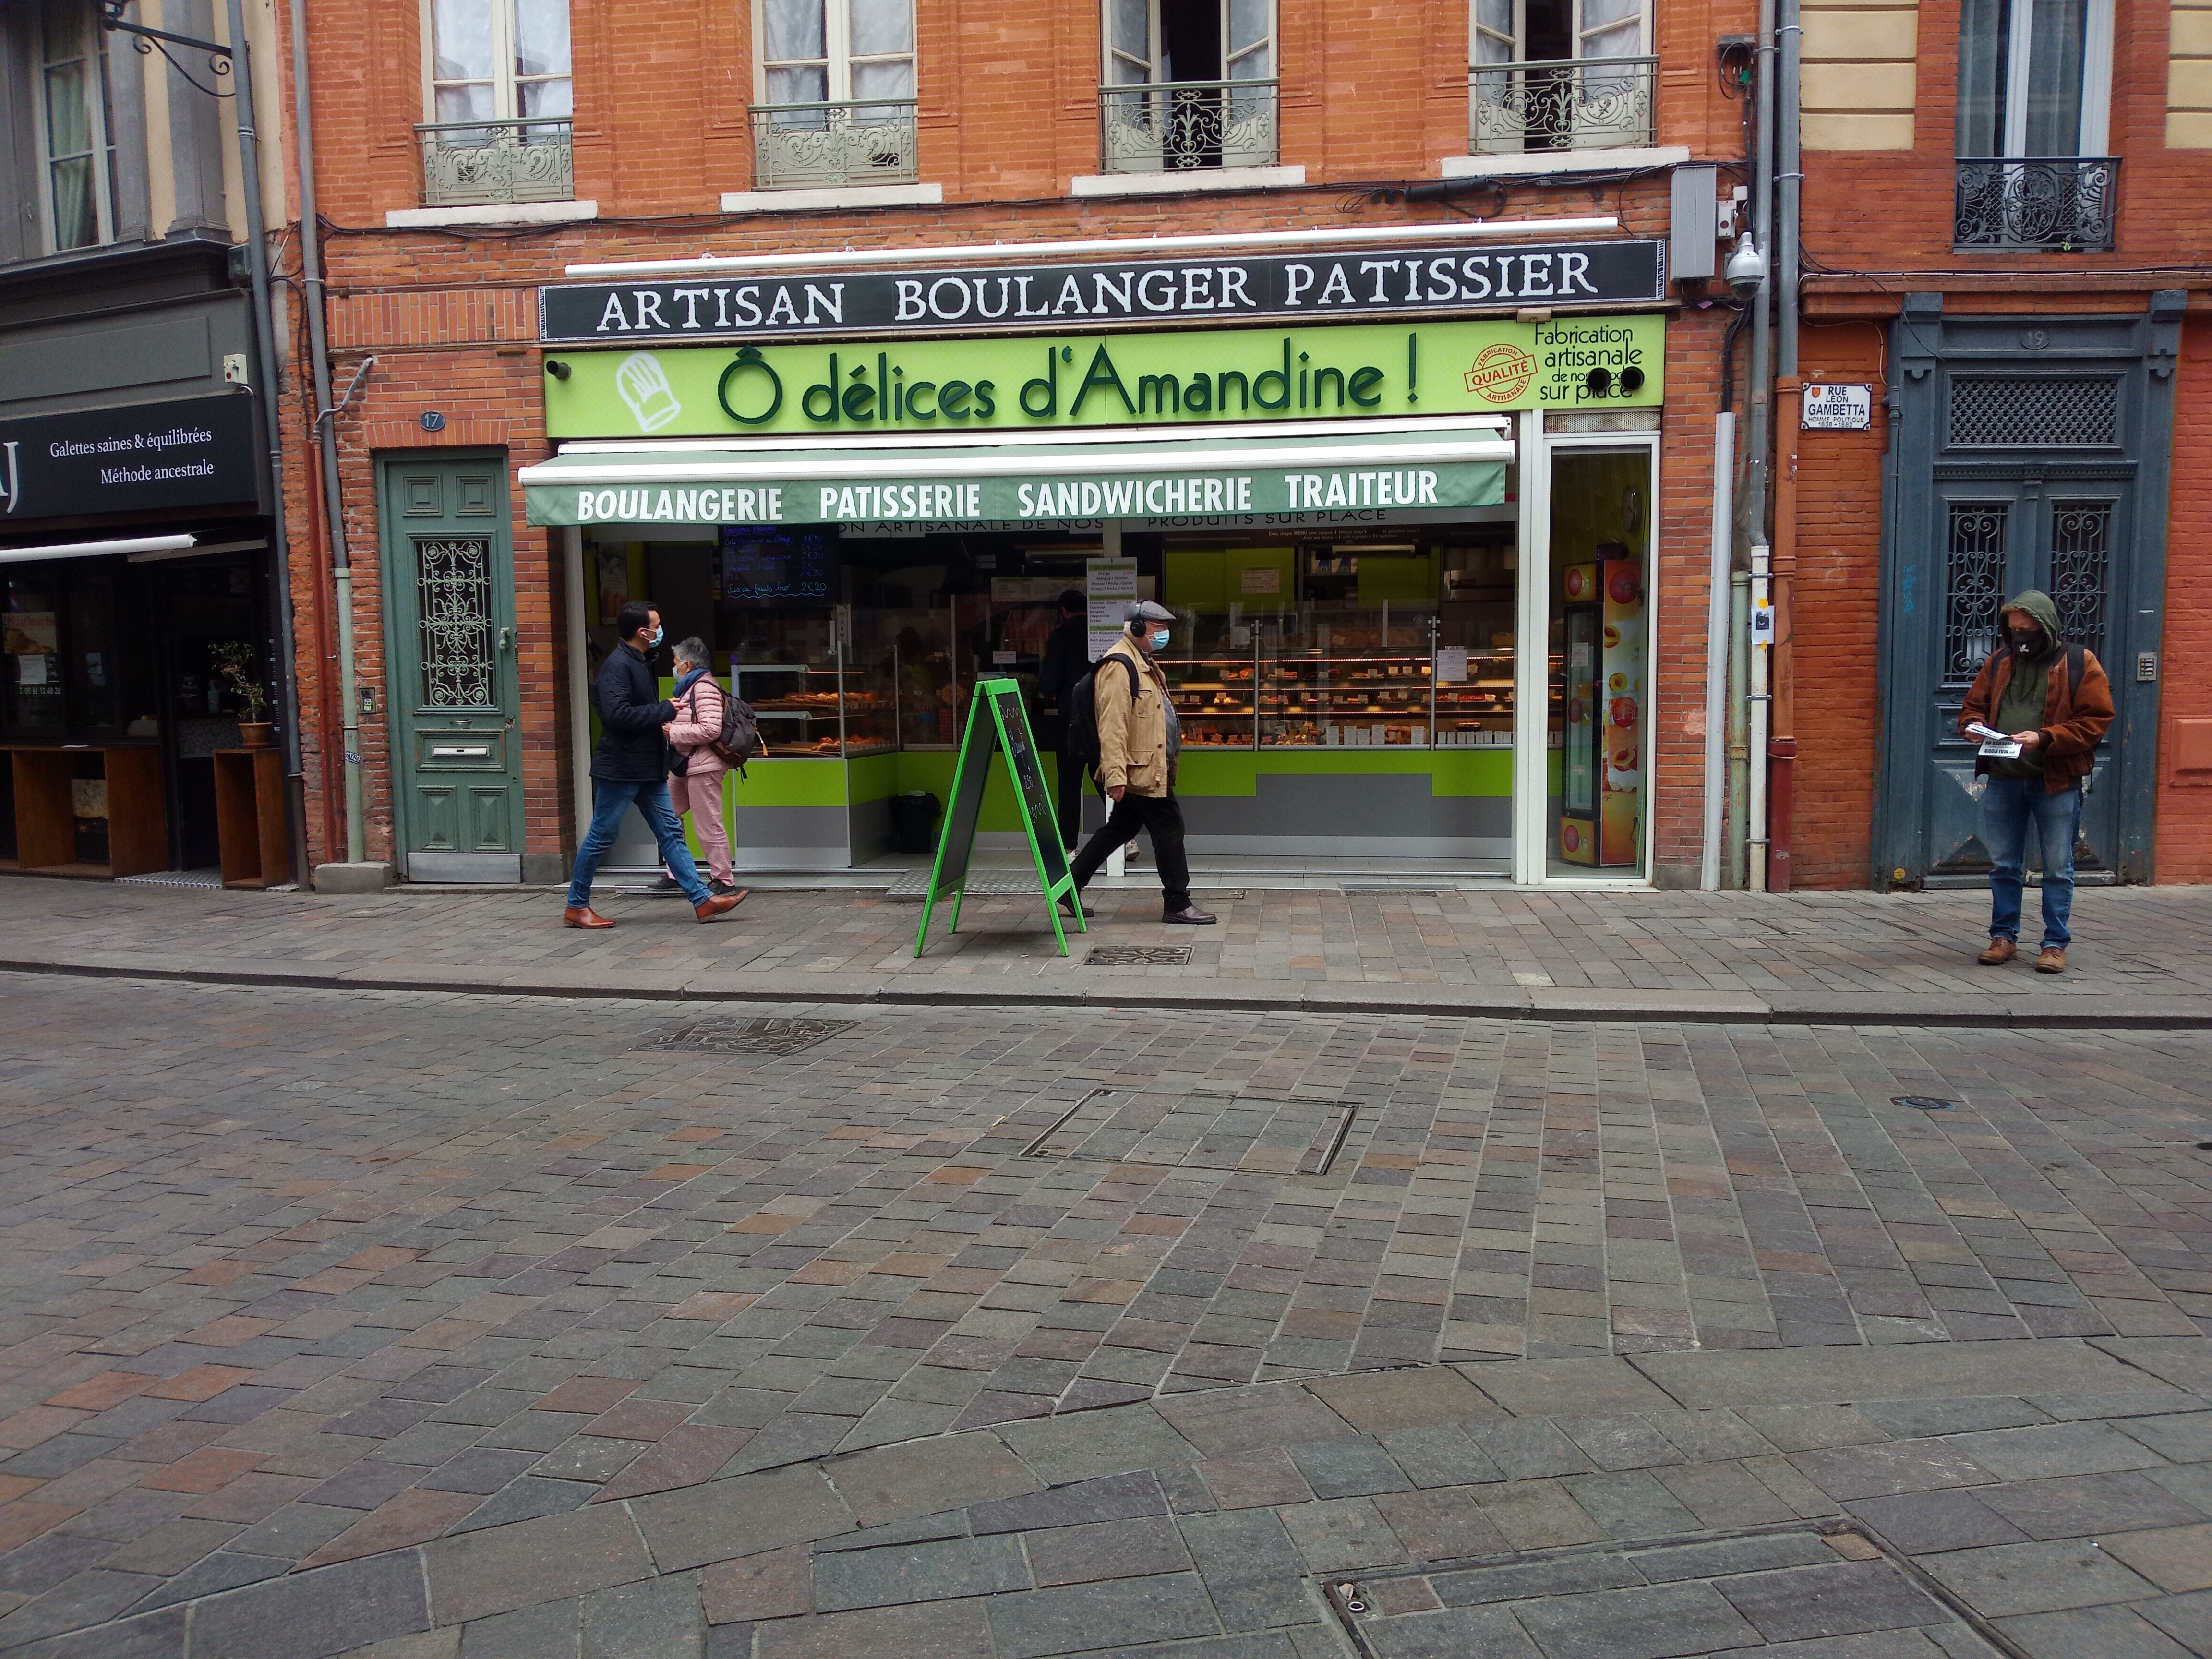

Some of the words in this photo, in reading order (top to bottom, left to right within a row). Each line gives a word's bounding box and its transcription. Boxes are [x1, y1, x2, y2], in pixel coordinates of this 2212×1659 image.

[596, 282, 845, 332] ARTISAN
[895, 266, 1256, 321] BOULANGER
[1284, 252, 1598, 305] PATISSIER
[1535, 322, 1633, 345] Fabrication
[2028, 330, 2044, 346] 19
[1478, 347, 1518, 366] FABRICATION
[1544, 337, 1643, 367] artisanale
[1472, 359, 1529, 386] QUALITÉ
[1552, 367, 1567, 383] de
[718, 344, 782, 424] Ô
[802, 352, 995, 422] délices
[1486, 378, 1527, 401] ARTISANALE
[1540, 384, 1570, 400] sur
[1828, 386, 1847, 395] RUE
[1826, 395, 1849, 403] LÉON
[425, 413, 440, 428] 17
[1809, 404, 1865, 416] GAMBETTA
[49, 441, 95, 458] Galettes
[97, 436, 132, 453] saines
[134, 434, 145, 449] &
[147, 427, 212, 452] équilibrées
[101, 465, 152, 485] Méthode
[154, 459, 214, 480] ancestrale
[577, 488, 783, 521] BOULANGERIE
[820, 483, 980, 519] PATISSERIE
[1018, 477, 1251, 517] SANDWICHERIE
[1285, 470, 1438, 508] TRAITEUR
[876, 520, 1011, 532] ARTISANALE
[1057, 518, 1103, 529] NOS
[1266, 512, 1306, 524] SUR
[1317, 509, 1386, 522] PLACE
[724, 538, 737, 548] Café
[727, 583, 740, 594] Jus
[742, 584, 751, 592] de
[753, 583, 773, 595] fruits
[776, 581, 791, 592] bio
[801, 582, 827, 591] 2€20
